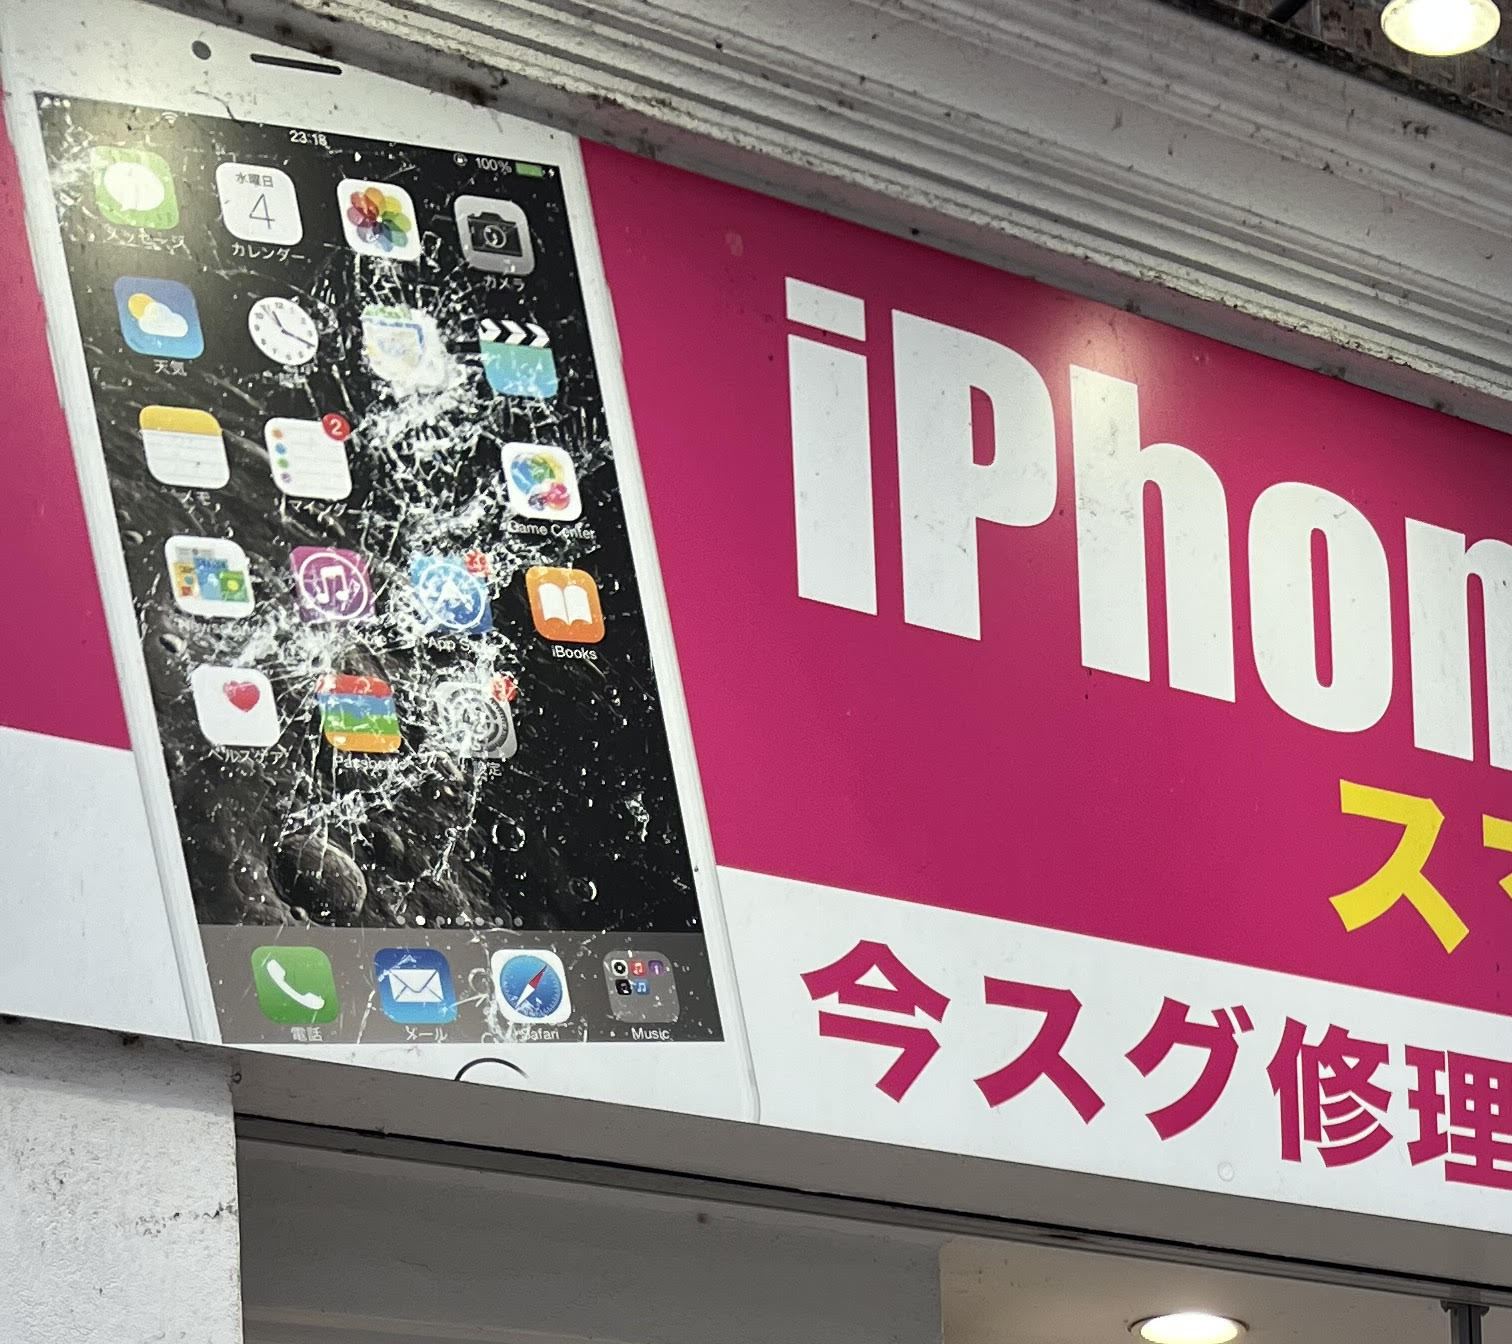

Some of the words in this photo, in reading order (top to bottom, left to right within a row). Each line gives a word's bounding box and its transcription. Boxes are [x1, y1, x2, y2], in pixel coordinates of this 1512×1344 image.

[289, 129, 328, 147] 23:18
[475, 157, 512, 173] 100%
[235, 172, 274, 188] 水曜日
[250, 194, 275, 229] 4
[232, 242, 306, 261] カレンダー
[484, 276, 525, 291] カメラ
[154, 359, 188, 376] 天気
[330, 419, 343, 436] 2
[507, 521, 548, 536] Game
[550, 524, 597, 540] Center
[428, 637, 451, 652] App
[552, 645, 598, 660] iBooks
[291, 1026, 323, 1043] 電話
[406, 1026, 448, 1041] メール
[519, 1026, 560, 1041] Safari
[632, 1027, 671, 1042] Music
